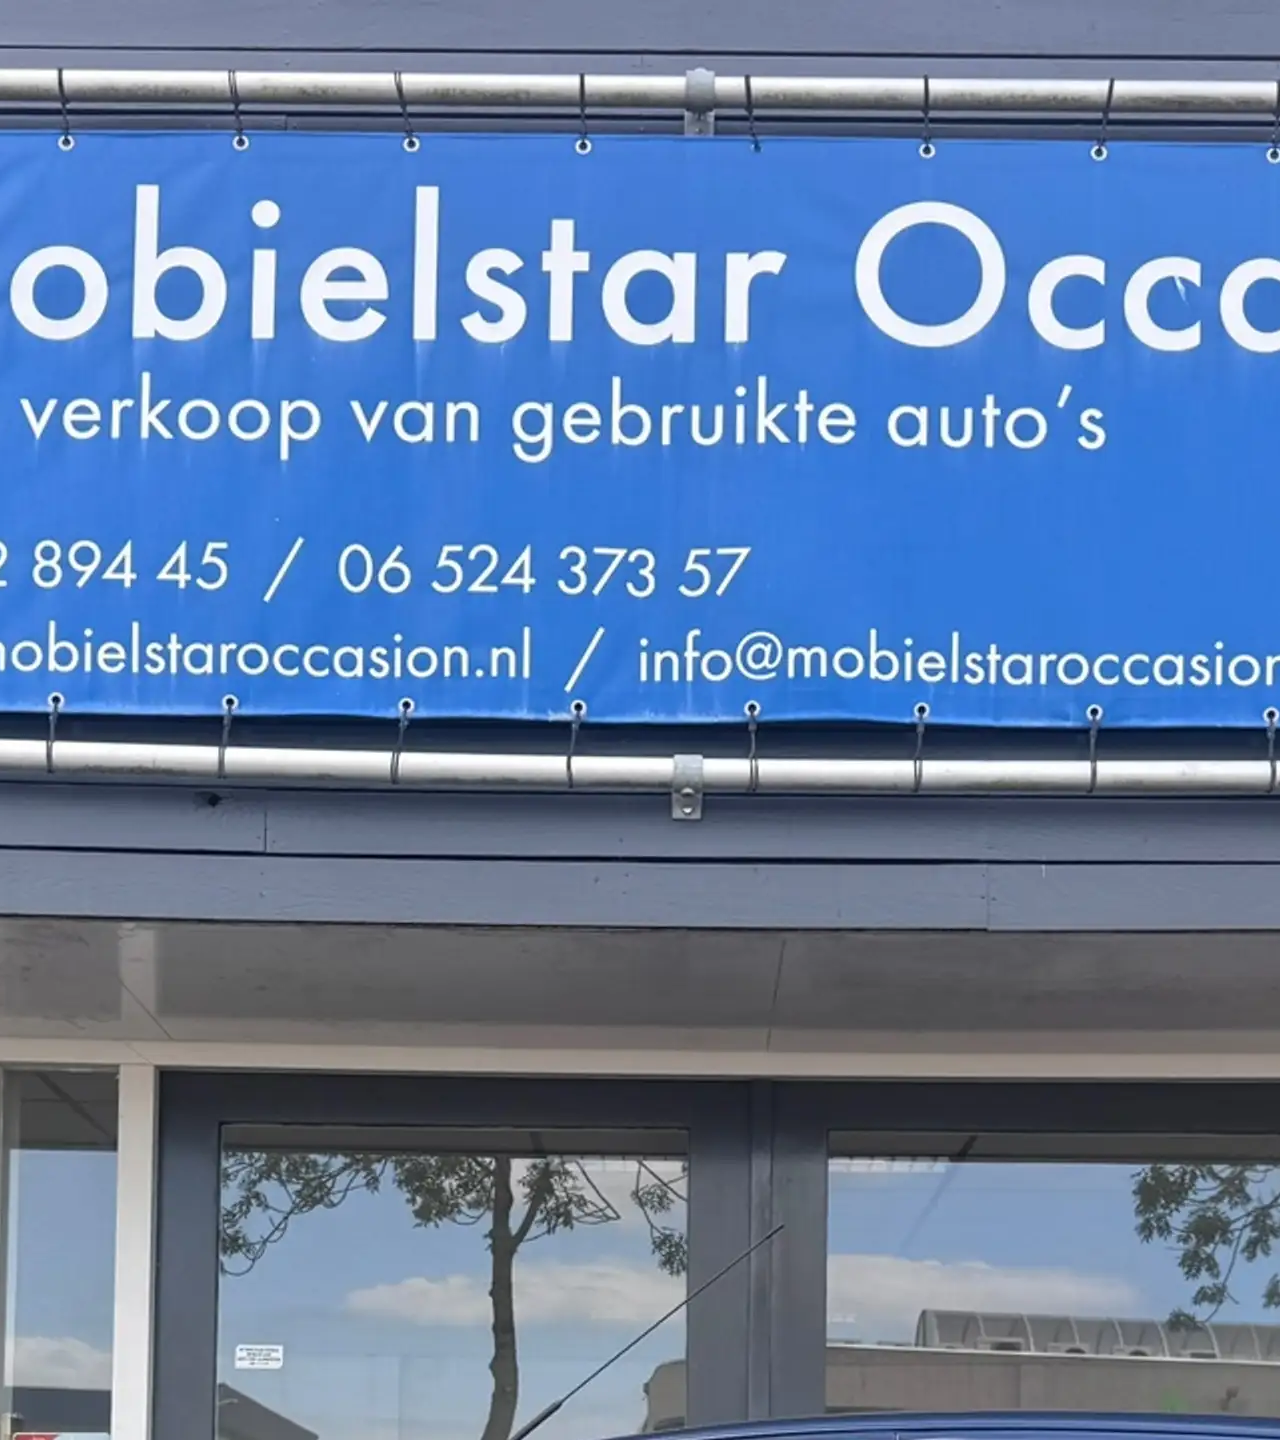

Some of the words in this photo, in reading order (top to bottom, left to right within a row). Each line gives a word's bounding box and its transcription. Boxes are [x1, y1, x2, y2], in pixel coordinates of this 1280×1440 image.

[20, 371, 321, 461] verkoop
[350, 400, 479, 443] van
[512, 375, 856, 463] gebruikte
[32, 539, 137, 588] 894
[156, 541, 228, 590] 45
[263, 537, 304, 602] /
[339, 543, 411, 594] 06
[431, 544, 536, 593] 524
[558, 545, 655, 598] 373
[679, 547, 751, 597] 57
[564, 627, 605, 693] /
